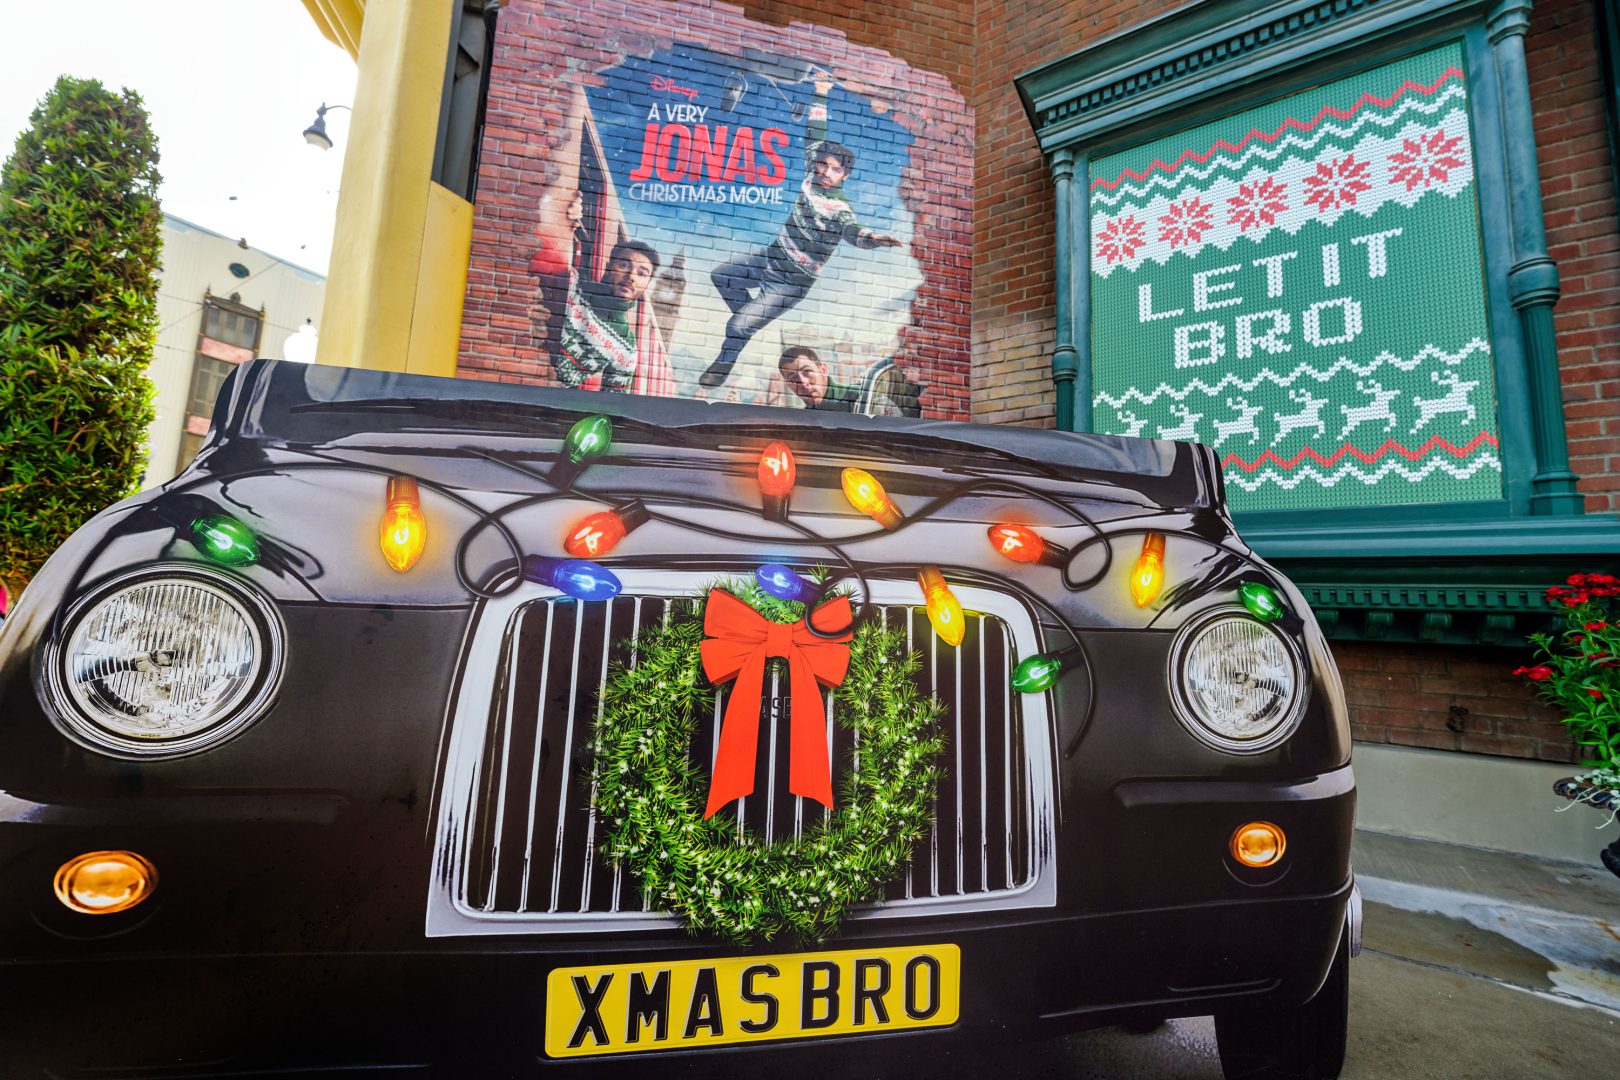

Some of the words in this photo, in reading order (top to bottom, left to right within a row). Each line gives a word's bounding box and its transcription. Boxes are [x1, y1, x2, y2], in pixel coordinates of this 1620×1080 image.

[648, 73, 699, 102] Disney
[647, 102, 661, 121] A
[665, 103, 709, 123] VERY
[629, 123, 789, 185] JONAS
[628, 182, 727, 204] CHRISTMAS
[729, 185, 784, 205] MOVIE
[1138, 250, 1298, 323] LET
[1322, 227, 1403, 288] IT
[1174, 296, 1363, 369] BRO
